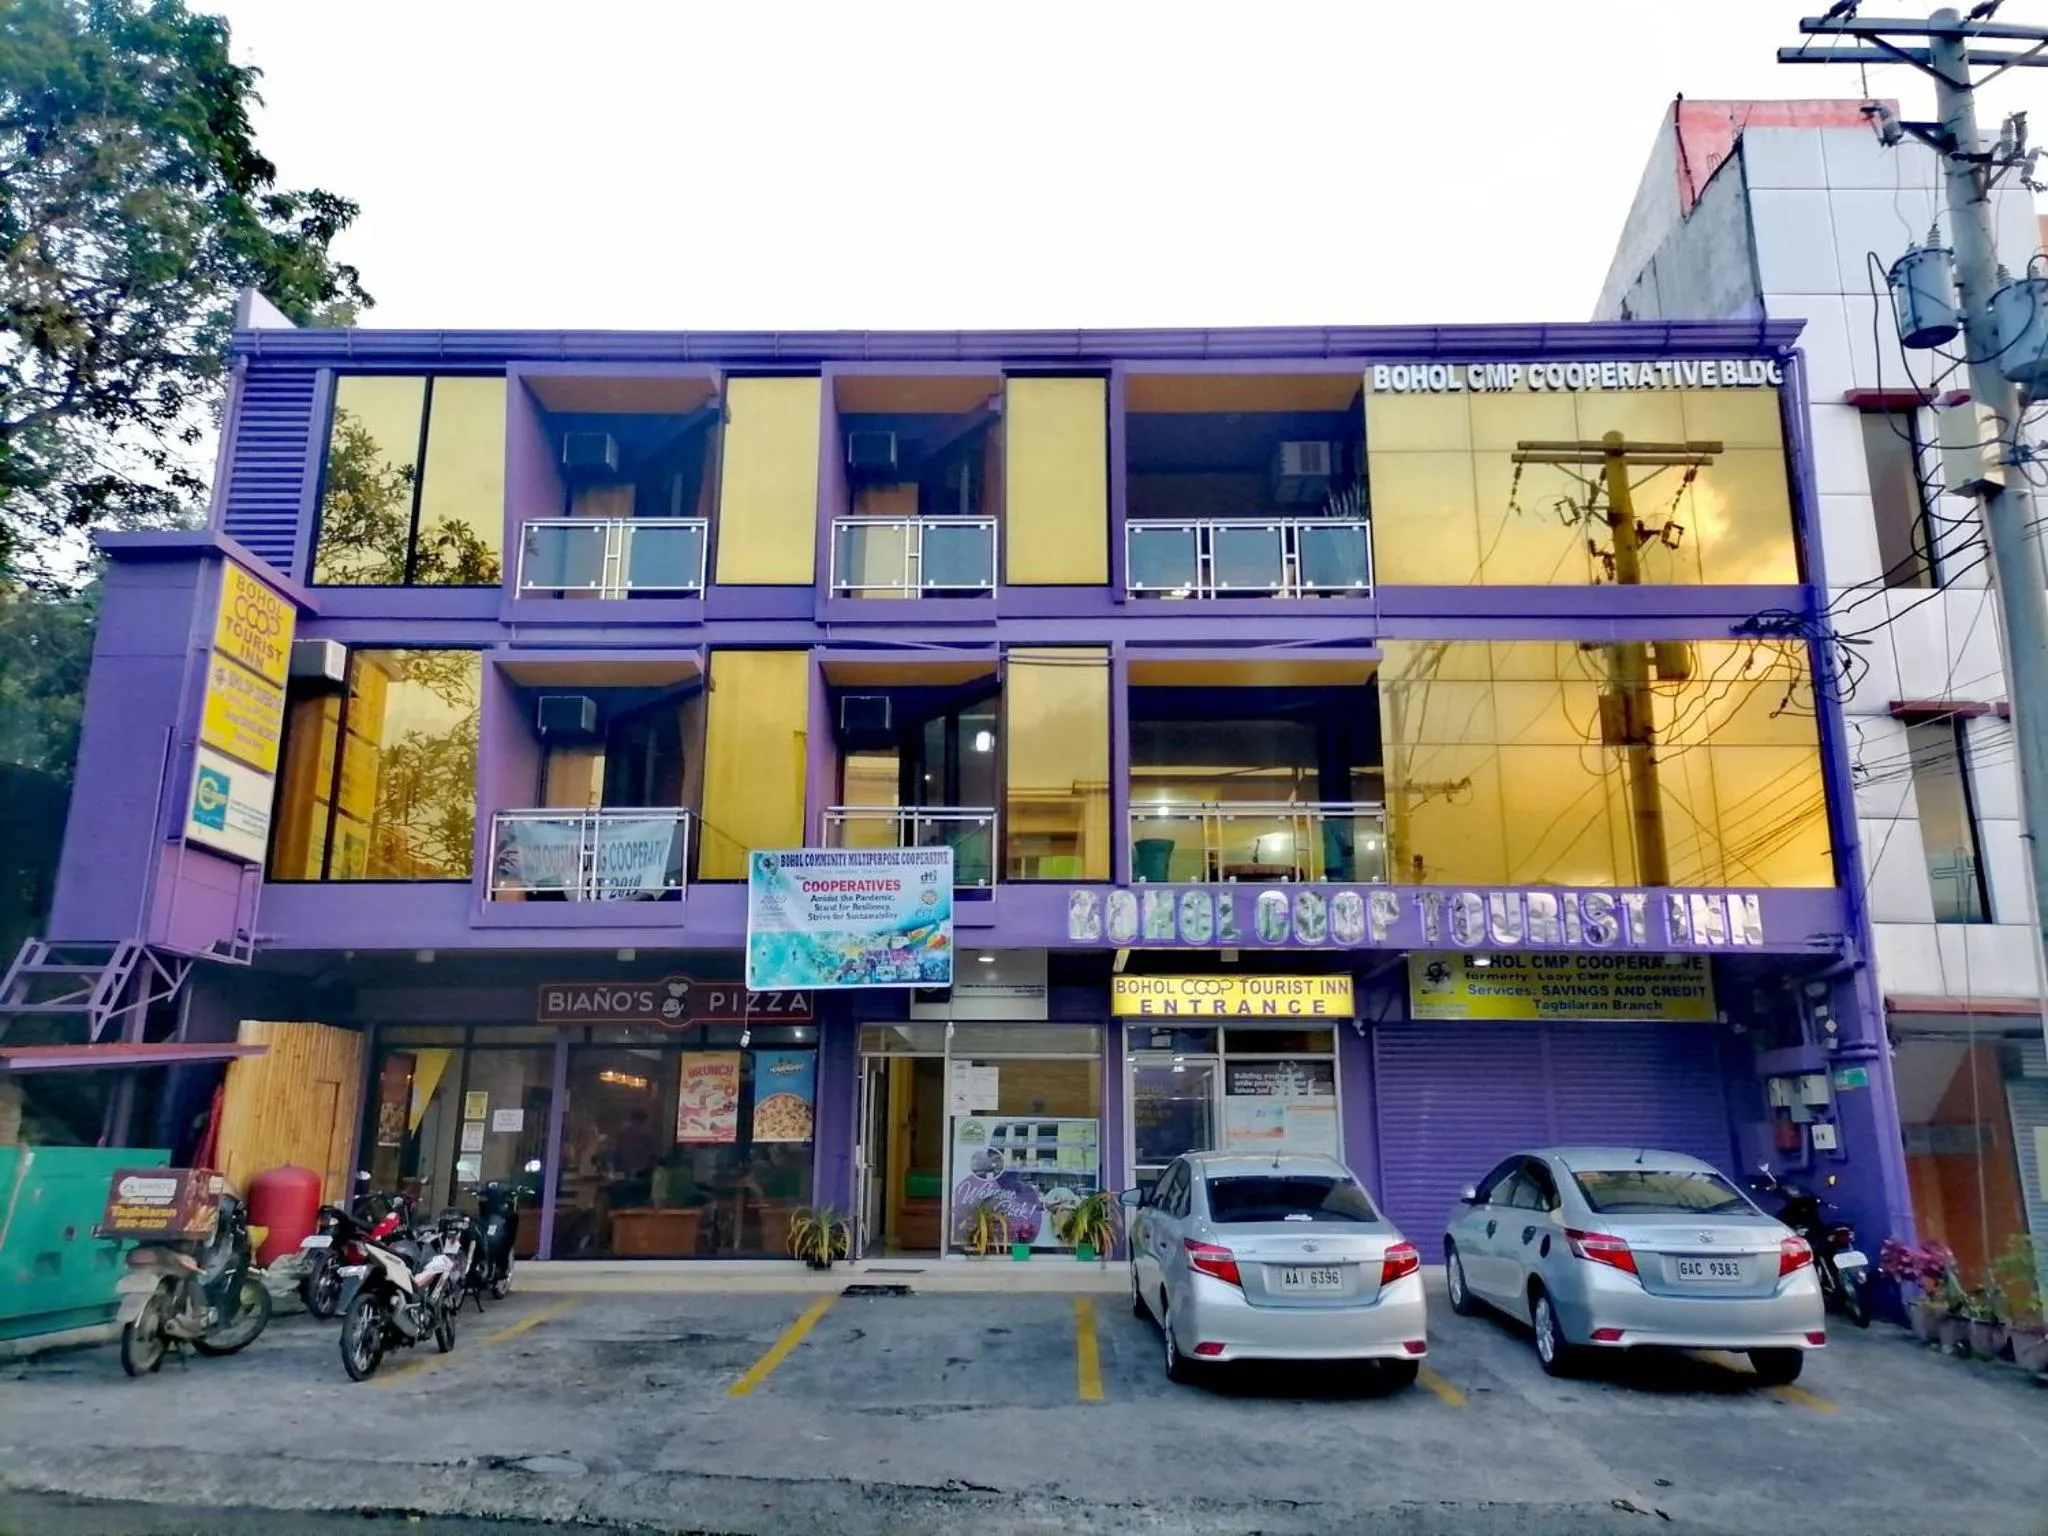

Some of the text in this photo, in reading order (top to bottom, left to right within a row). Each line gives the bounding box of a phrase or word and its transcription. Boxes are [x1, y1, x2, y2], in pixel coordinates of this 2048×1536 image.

[1373, 358, 1784, 391] BOHOL CMP COOPERATIVE BLDG
[236, 575, 284, 620] BOHOL
[235, 594, 280, 636] COOP
[225, 616, 283, 664] TOURIST
[240, 643, 265, 669] INN
[780, 850, 949, 868] BOHOL COMMUNITY MULTIPURPOSE COOPERATIVE
[802, 880, 901, 893] COOPERATIVES
[840, 894, 853, 902] the
[833, 912, 845, 920] for
[1068, 889, 1765, 947] BOHOL COOP TOURIST INN
[1464, 954, 1704, 970] BHOL CMP COOPERAVE
[1577, 972, 1610, 982] CMP
[1614, 972, 1704, 983] Cooperative
[1116, 979, 1349, 995] BOHOL COOP TOURIST INN
[1542, 985, 1609, 997] SAVINGS
[1614, 985, 1646, 997] AND
[1651, 985, 1707, 997] CREDIT
[548, 987, 809, 1012] BIAÑO'S PIZZA
[1140, 999, 1326, 1014] ENTRANCE
[1534, 1000, 1663, 1013] Tagbilaran Branch
[956, 1179, 1018, 1207] Welcome
[1680, 1262, 1740, 1275] GAC 9383
[1311, 1270, 1339, 1285] 6396
